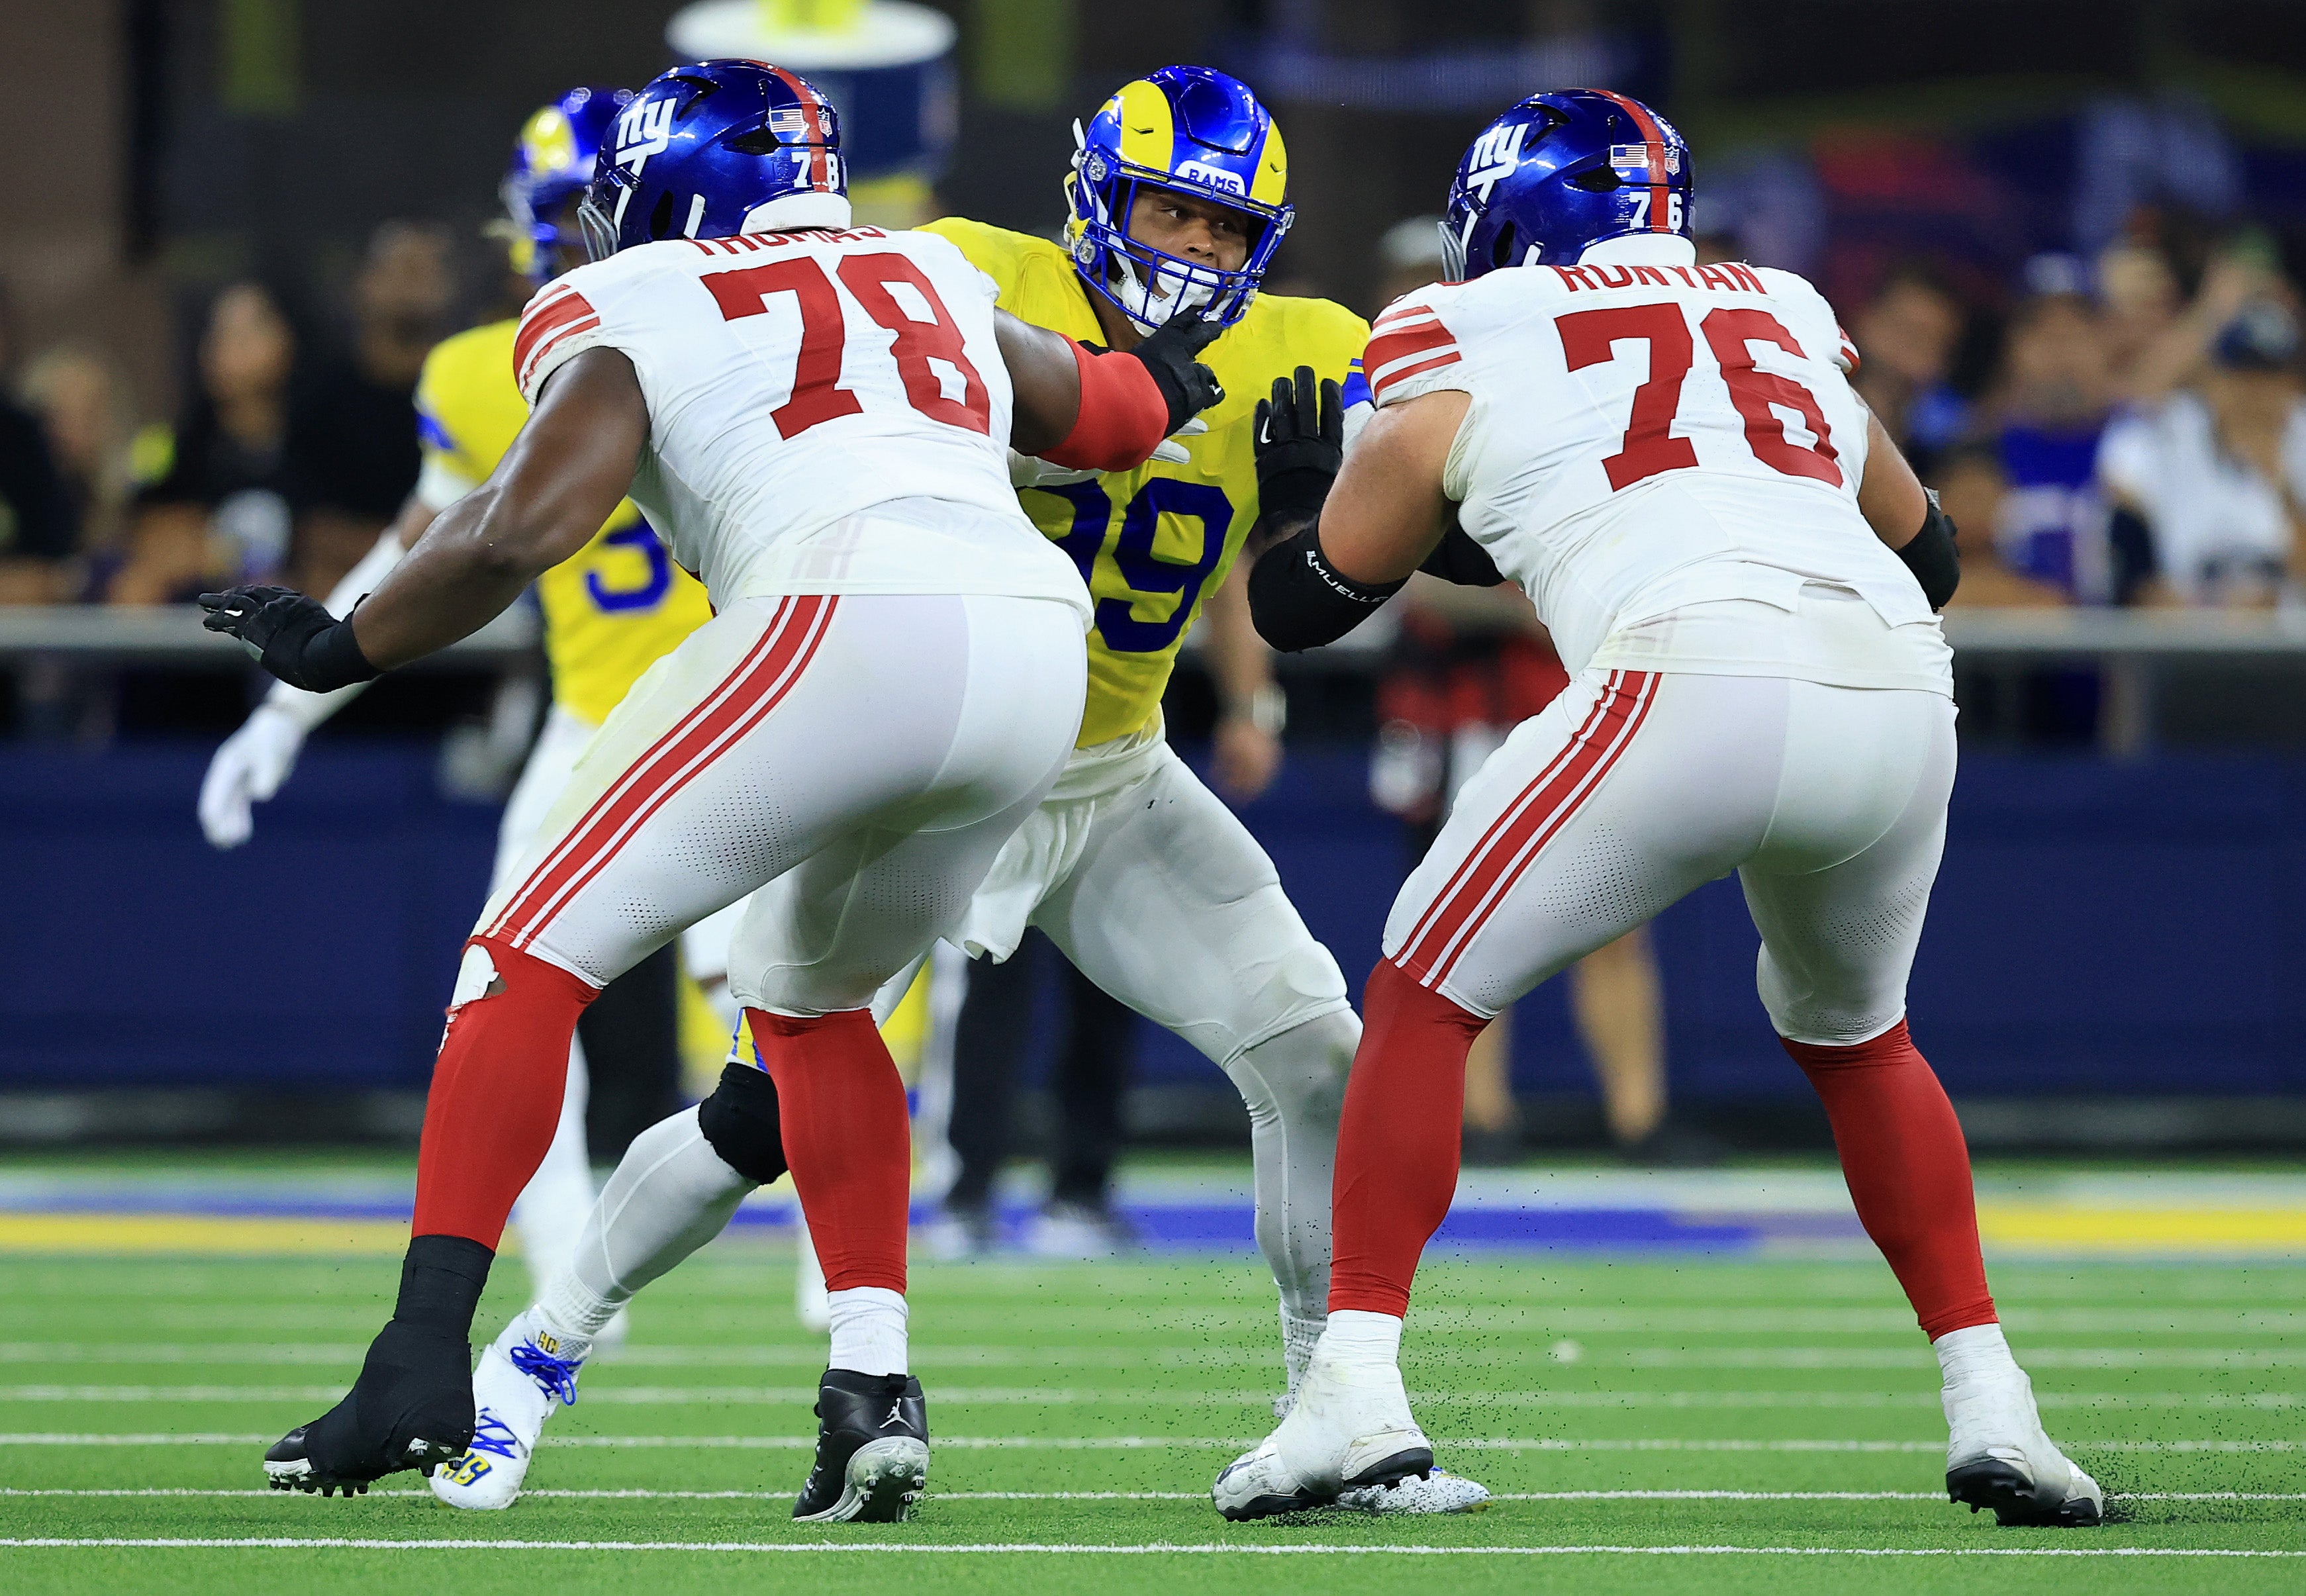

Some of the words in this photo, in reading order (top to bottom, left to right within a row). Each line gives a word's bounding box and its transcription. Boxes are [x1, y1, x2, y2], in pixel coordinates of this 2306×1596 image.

[791, 152, 840, 190] 78
[1188, 168, 1239, 193] RAMS
[1629, 191, 1682, 230] 76
[699, 252, 991, 440] 78
[1553, 302, 1843, 493] 76
[1312, 561, 1388, 602] MUELLE
